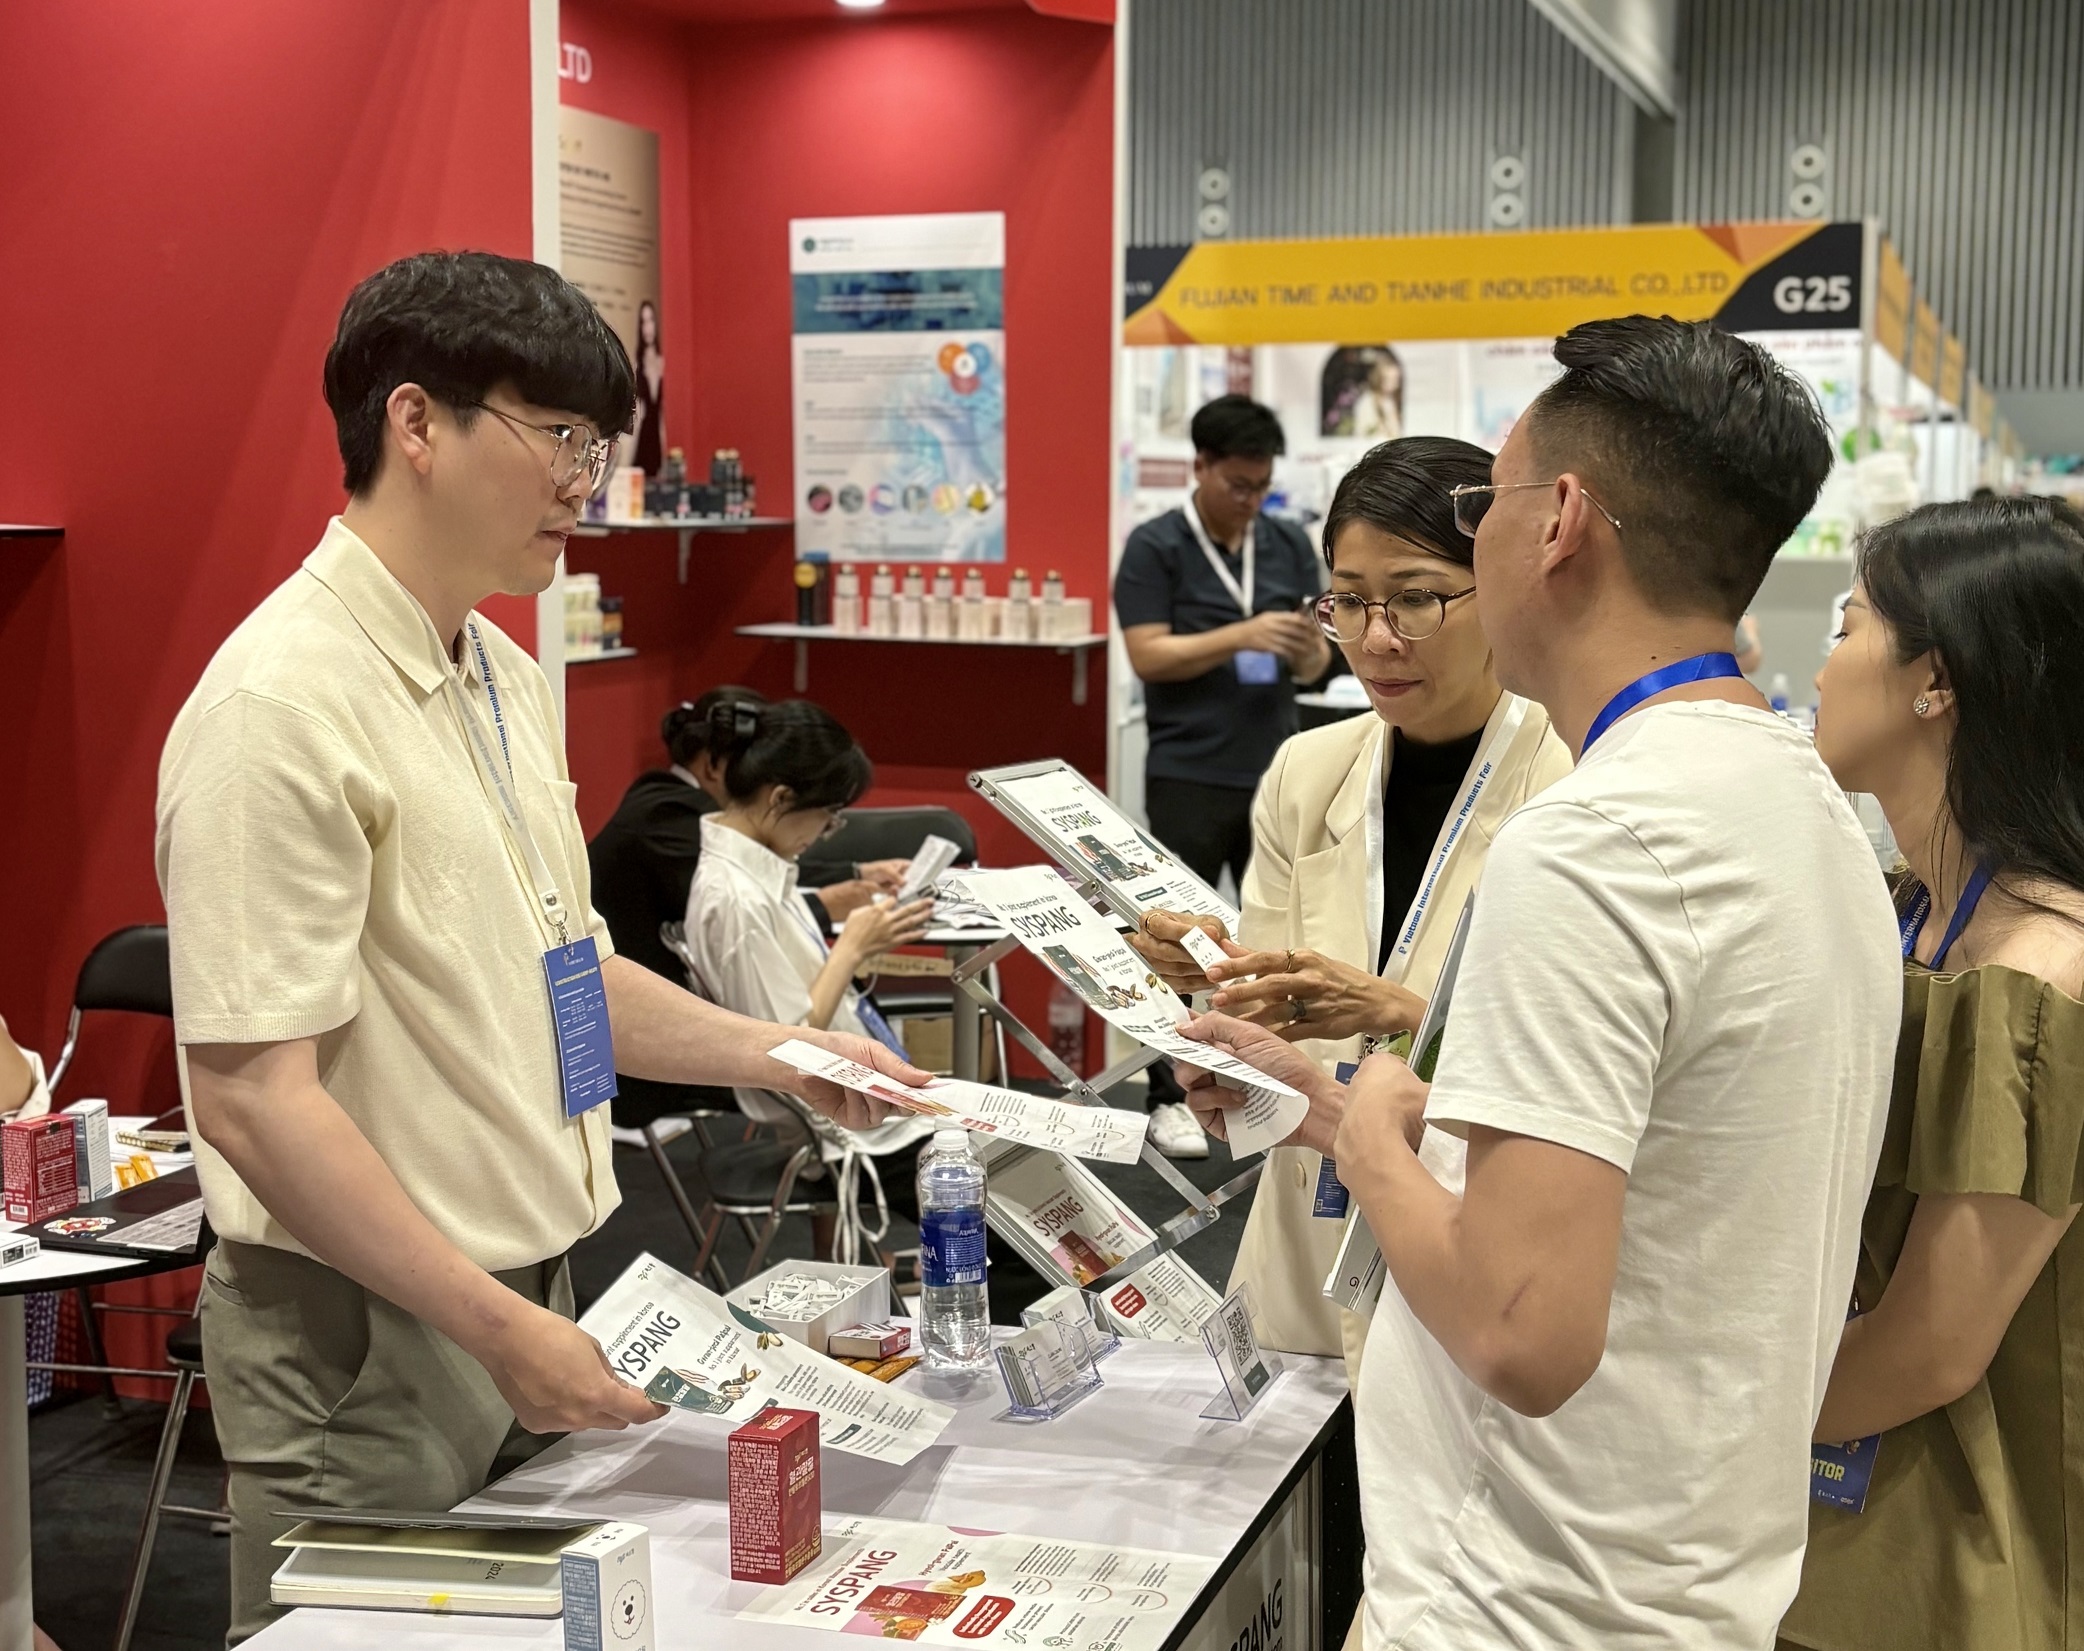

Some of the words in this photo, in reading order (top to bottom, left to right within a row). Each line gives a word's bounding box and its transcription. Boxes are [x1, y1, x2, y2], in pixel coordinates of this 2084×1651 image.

[1180, 286, 1258, 310] FUJIAN
[1267, 284, 1317, 307] TIME
[1328, 281, 1378, 306] AND
[1387, 278, 1471, 304] TIANHE
[1481, 275, 1617, 301] INDUSTRIAL
[1774, 275, 1851, 314] G25
[468, 623, 479, 640] Fair
[476, 642, 493, 682] Products
[488, 684, 503, 723] Premium
[1052, 810, 1101, 832] SYSPANG
[1403, 909, 1423, 944] Vietnam
[1419, 854, 1446, 909] International
[1441, 813, 1464, 853] Premium
[1459, 780, 1483, 817] Products
[1479, 761, 1492, 779] Fair
[1010, 906, 1081, 939] SYSPANG
[1033, 1196, 1084, 1237] SYSPANG
[613, 1310, 681, 1380] YSPANG
[810, 1549, 898, 1616] SYSPANG
[1231, 1578, 1283, 1651] PANG
